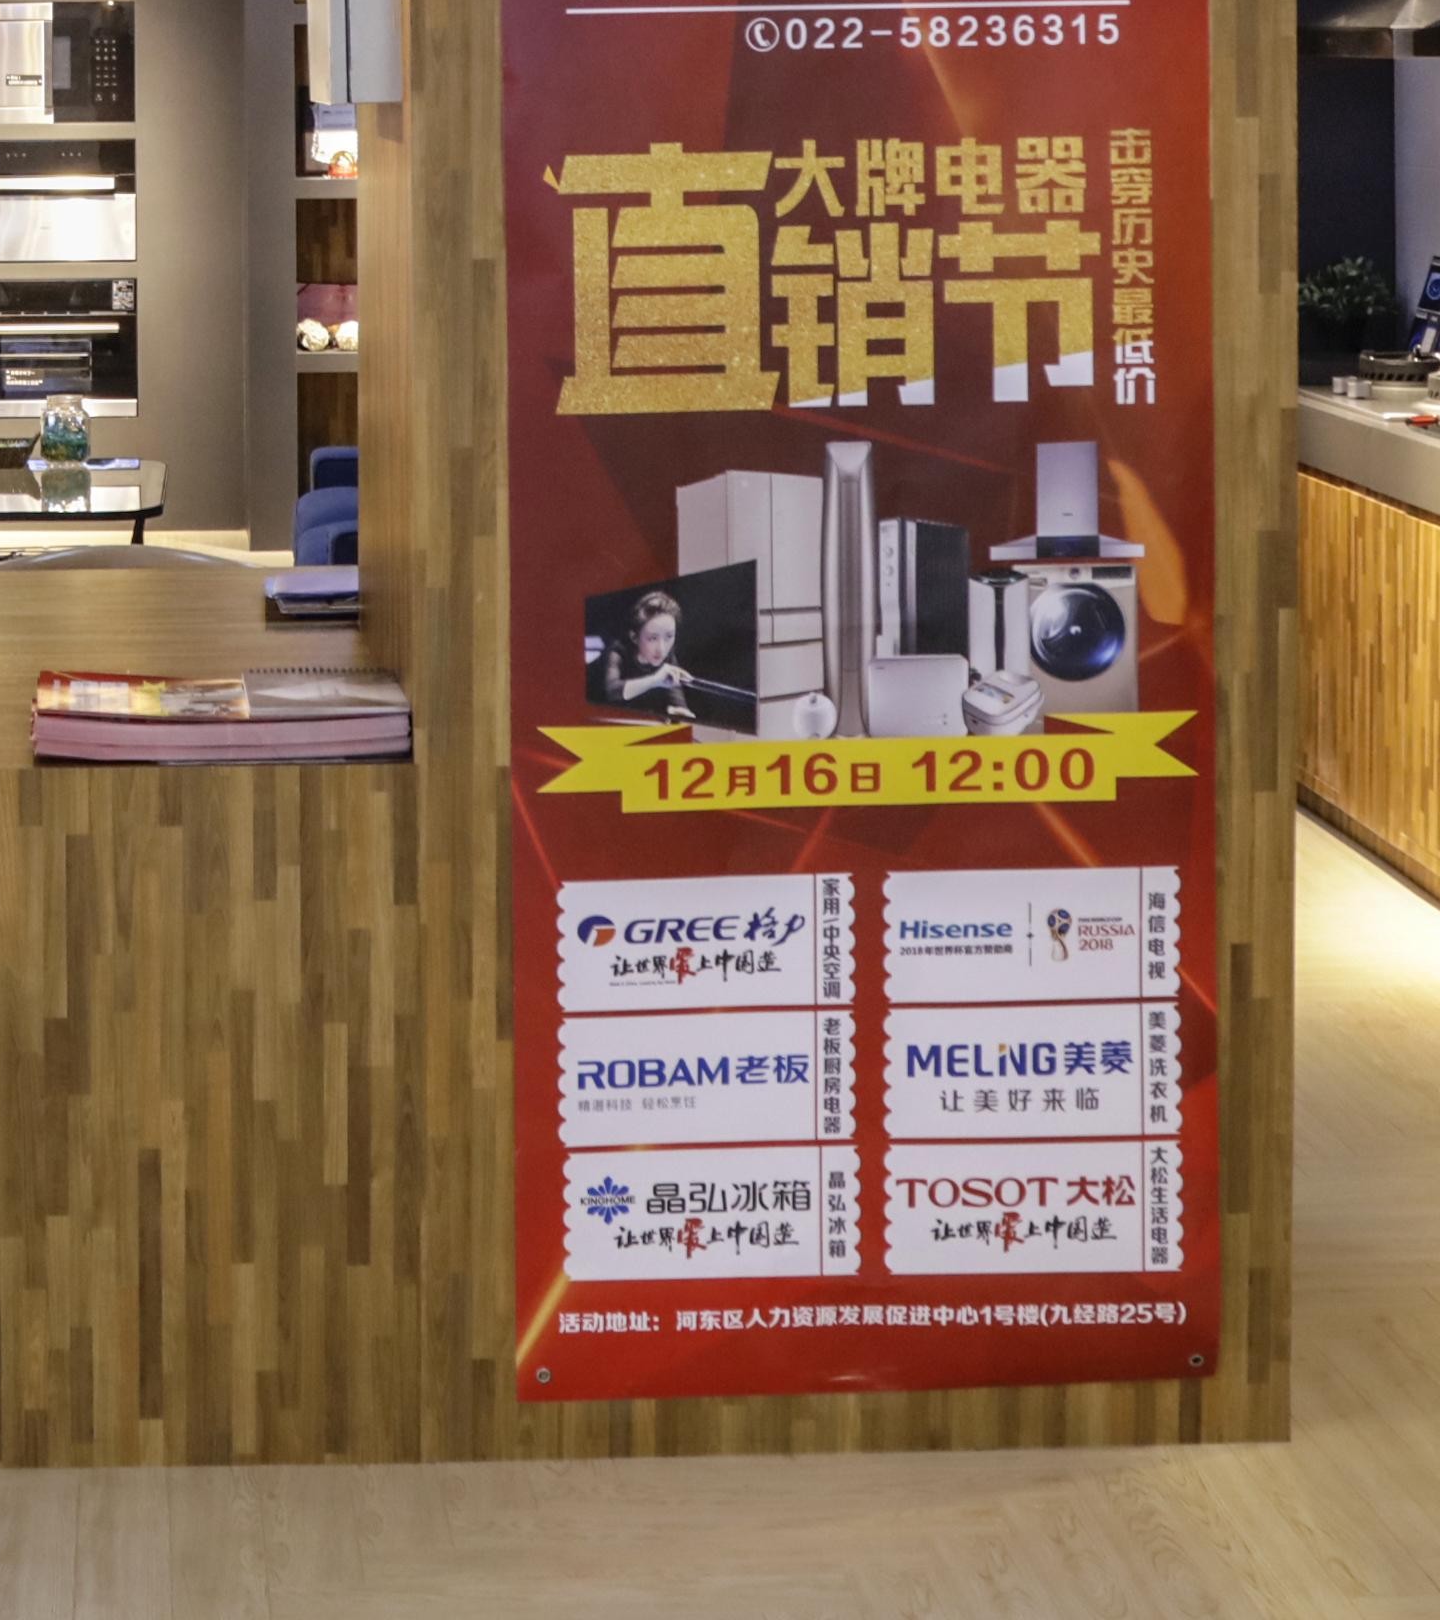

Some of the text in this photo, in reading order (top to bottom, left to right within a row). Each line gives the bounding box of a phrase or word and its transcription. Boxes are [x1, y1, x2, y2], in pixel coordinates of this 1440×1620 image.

[784, 13, 1120, 50] 022-58236315
[774, 136, 1087, 218] 大牌电器
[555, 141, 1101, 415] 直销节
[1110, 127, 1156, 405] 击穿历史最低价
[643, 746, 1096, 801] 12月16日 12:00
[624, 916, 740, 944] GREE
[900, 920, 1013, 940] Hisense
[1078, 924, 1136, 937] RUSSIA
[1079, 938, 1114, 951] 2018
[1148, 891, 1166, 980] 海信电视
[577, 1057, 730, 1090] ROBAM
[822, 1016, 842, 1134] 老板厨房电器
[1064, 1040, 1135, 1075] 美菱
[1148, 1010, 1168, 1124] 美菱洗衣机
[940, 1088, 1099, 1113] 让美好来临
[646, 1180, 812, 1214] 晶弘冰箱
[896, 1175, 1136, 1209] TOSOT 大松
[1150, 1146, 1169, 1265] 大松生活电器
[828, 1170, 848, 1259] 晶弘冰箱
